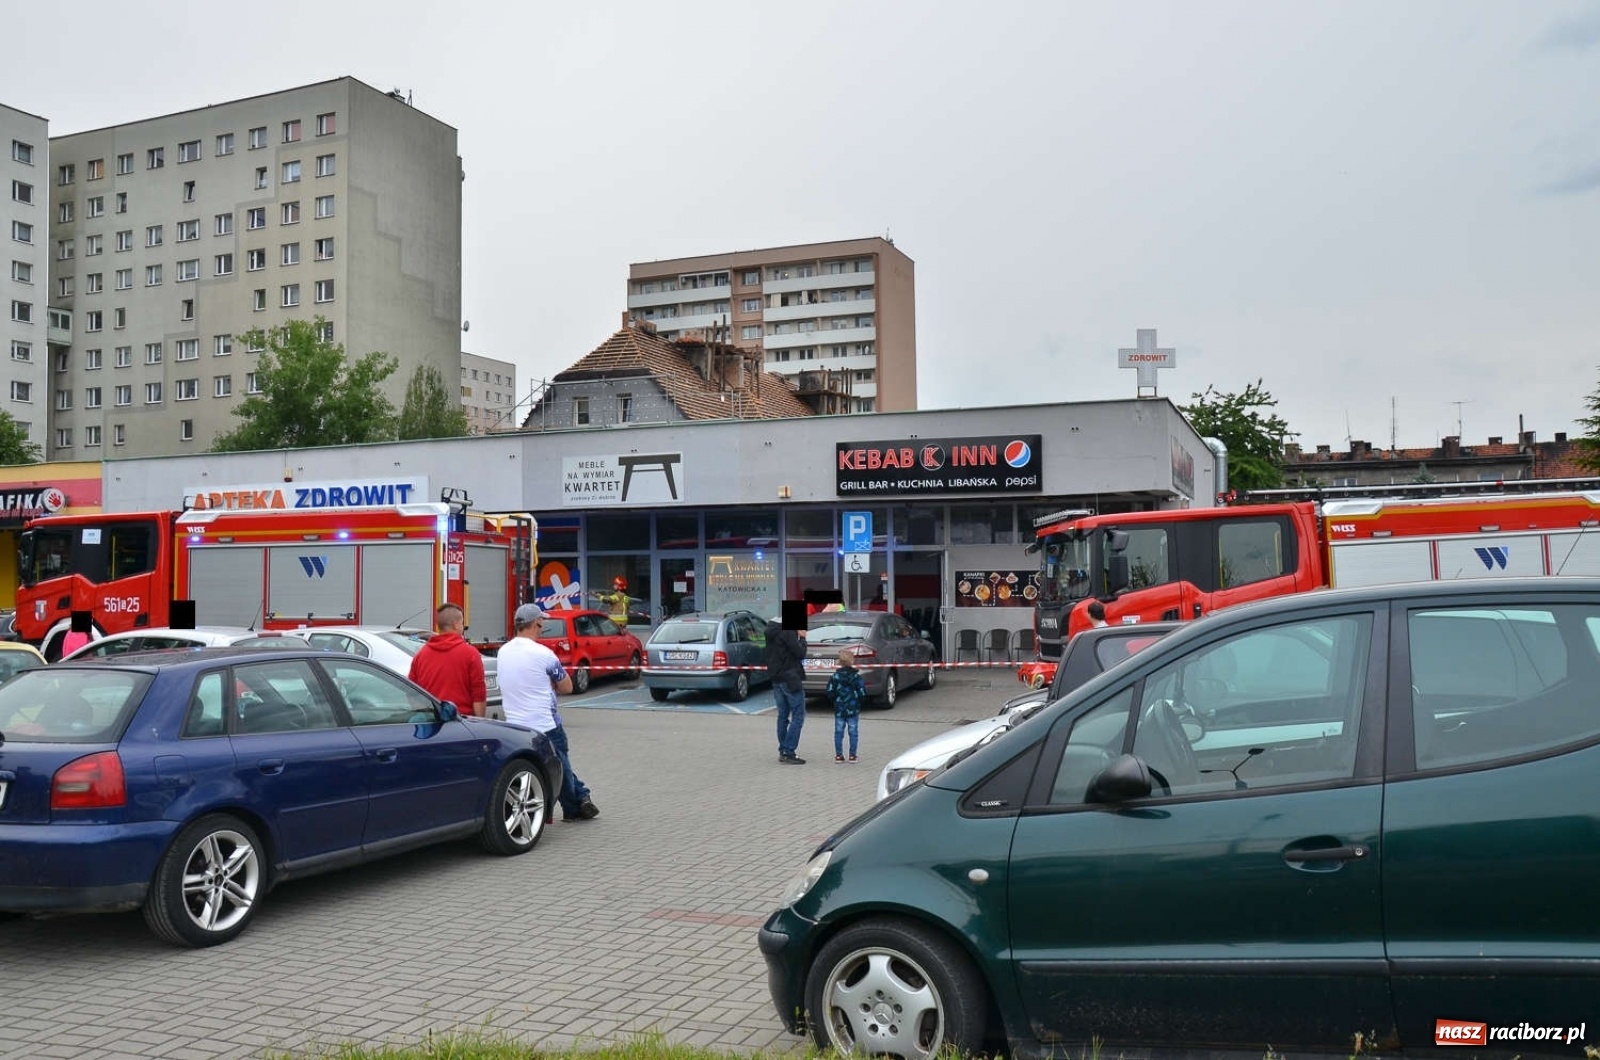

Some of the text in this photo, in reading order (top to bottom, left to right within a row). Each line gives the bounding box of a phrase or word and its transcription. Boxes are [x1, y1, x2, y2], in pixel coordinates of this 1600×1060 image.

[1128, 354, 1169, 362] ZDROWIT
[838, 447, 915, 470] KEBAB
[951, 445, 997, 467] INN
[578, 460, 606, 469] MEBLE
[567, 470, 615, 480] NA WYMIAR
[1005, 475, 1037, 487] pepsi
[564, 480, 620, 493] KWARTET
[840, 476, 998, 491] GRILL BAR KUCHNIA LIBAŃSKA
[193, 483, 412, 510] APTEKA ZDROWIT
[849, 515, 866, 541] P
